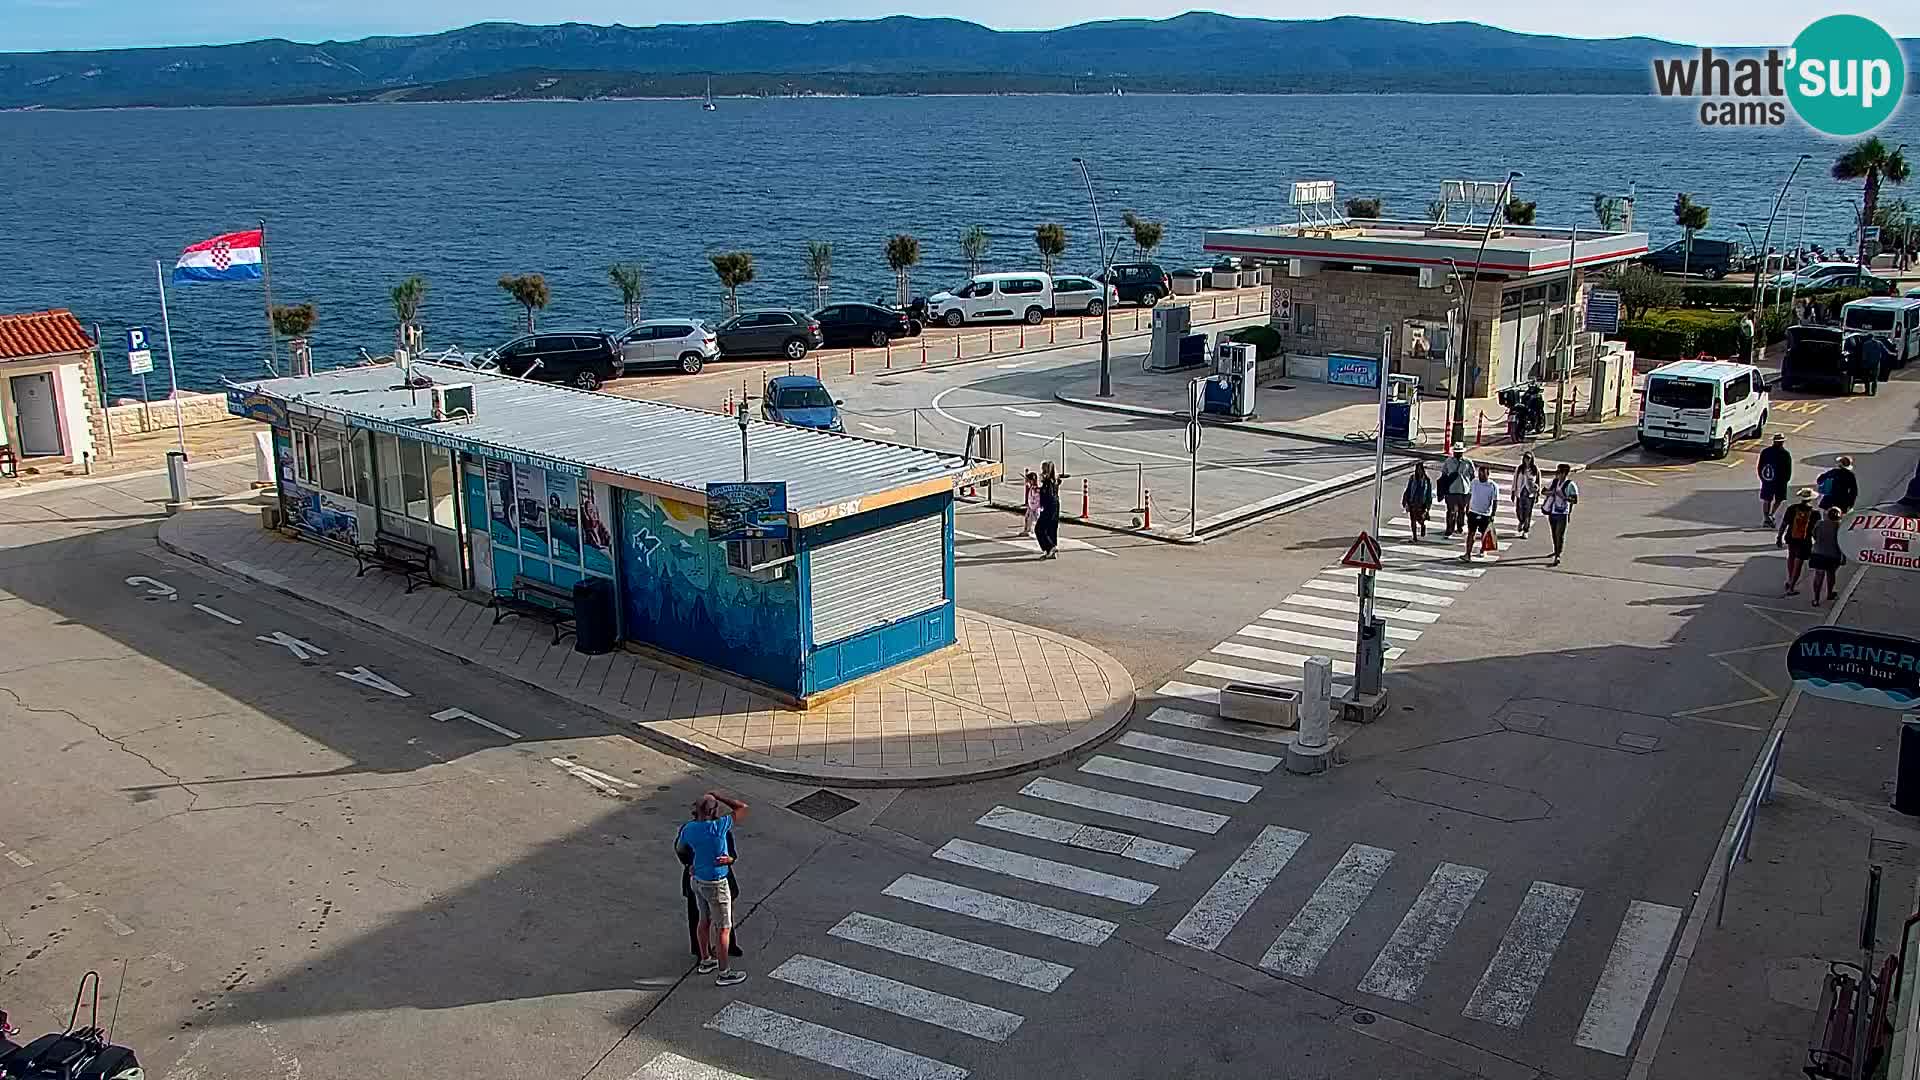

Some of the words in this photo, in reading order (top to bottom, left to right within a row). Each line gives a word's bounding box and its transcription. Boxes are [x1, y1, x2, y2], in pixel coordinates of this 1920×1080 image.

[131, 330, 144, 349] P
[438, 437, 468, 452] POSTAJA
[479, 445, 494, 457] BUS
[495, 449, 527, 465] STATION
[529, 455, 555, 471] TICKET
[556, 462, 583, 477] OFFICE
[1848, 515, 1920, 534] PIZZE
[1880, 529, 1917, 541] GRILL
[1870, 664, 1896, 680] bar
